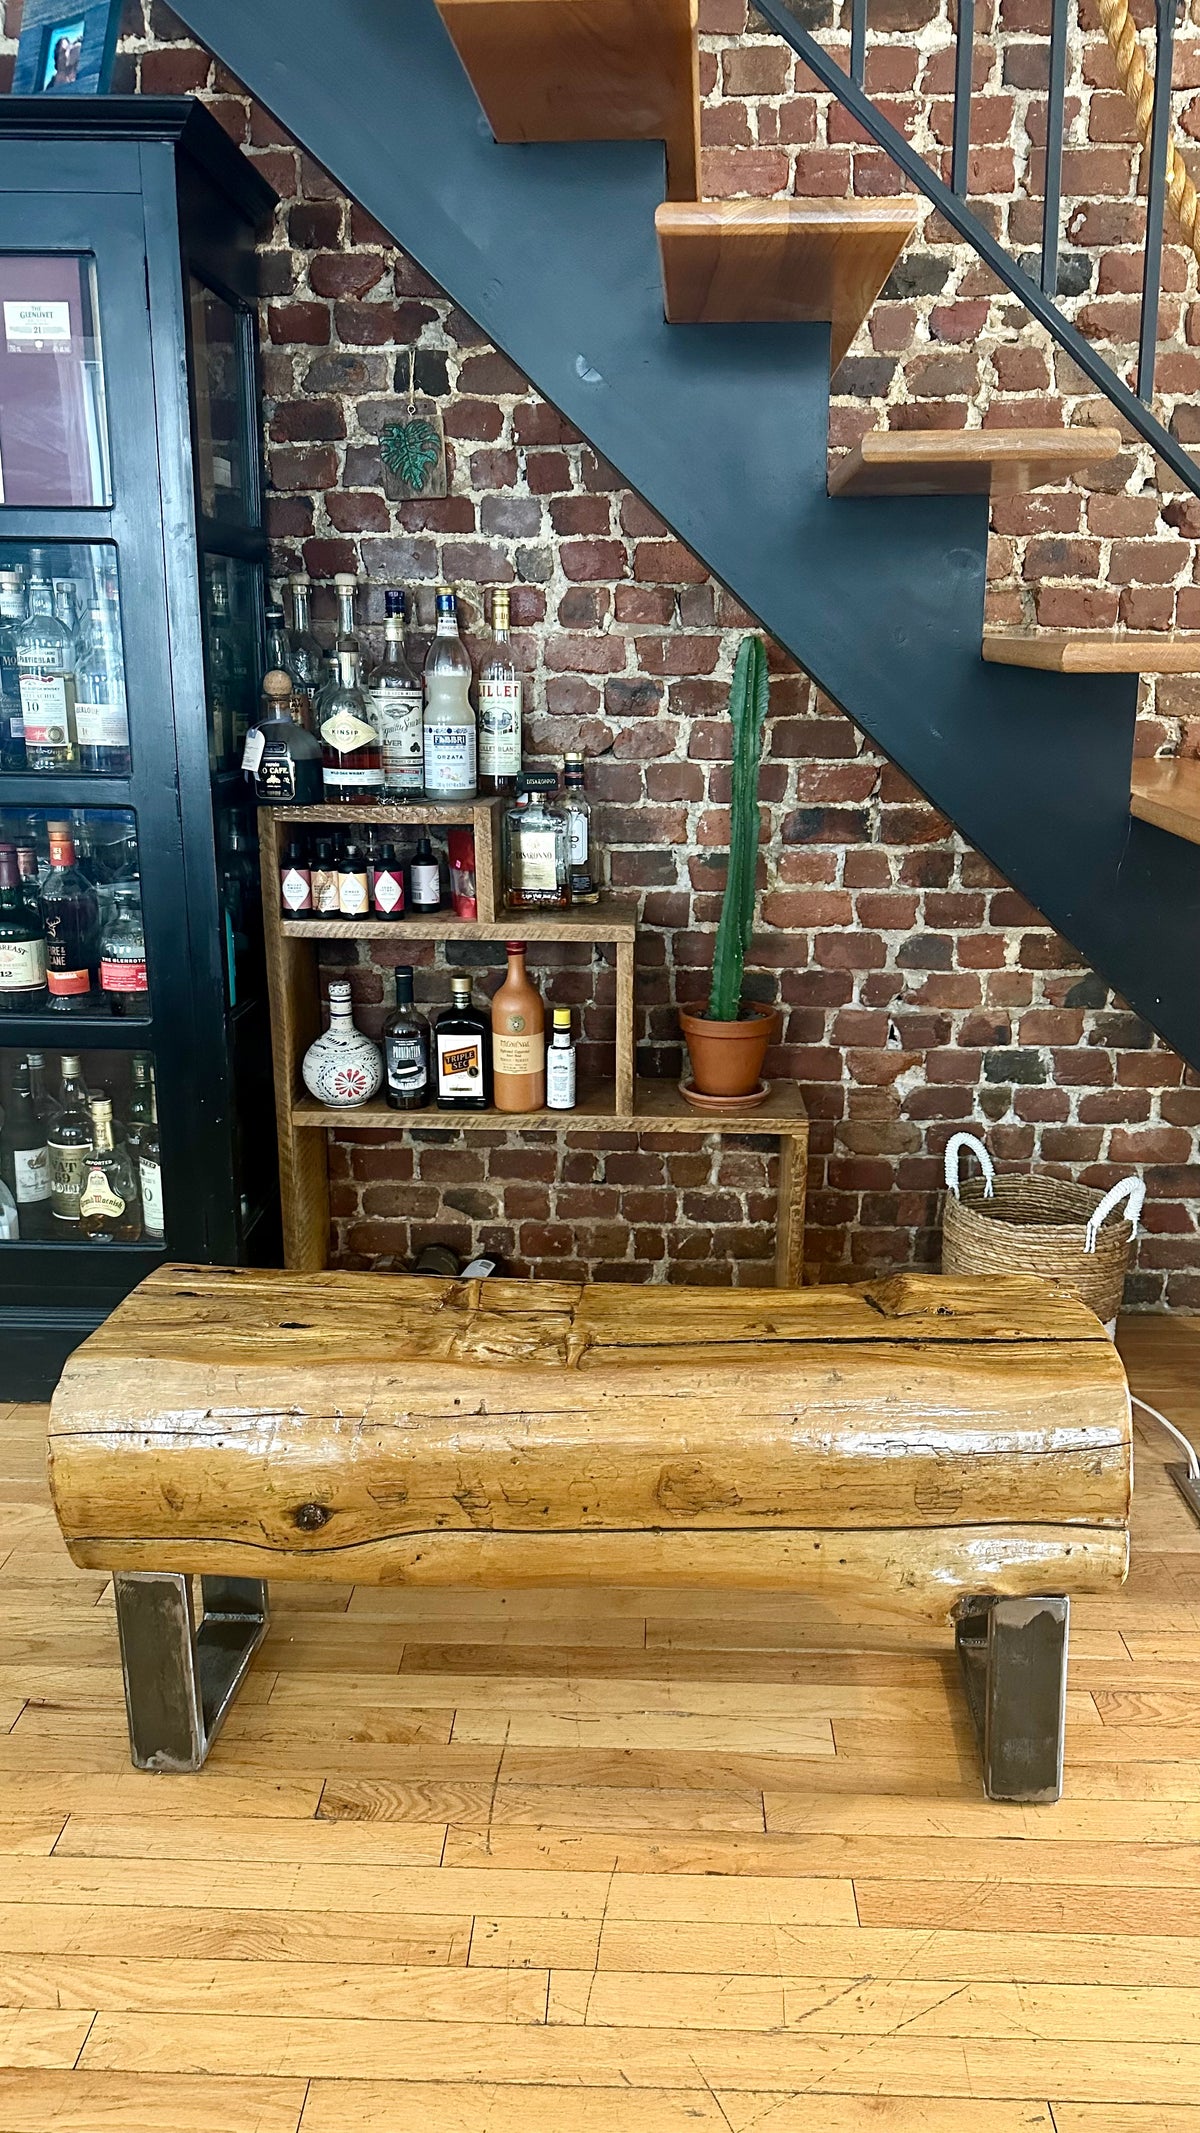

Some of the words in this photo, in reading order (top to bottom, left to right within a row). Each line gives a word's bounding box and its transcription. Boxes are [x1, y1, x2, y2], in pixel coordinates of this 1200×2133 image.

[20, 311, 53, 319] GLENLIVET
[33, 326, 42, 334] 21
[26, 701, 39, 712] 10
[434, 735, 465, 744] FABBRI
[445, 1051, 474, 1064] TRIPLE
[452, 1060, 469, 1069] SEC
[51, 1160, 77, 1173] VAT
[54, 1172, 71, 1183] 69
